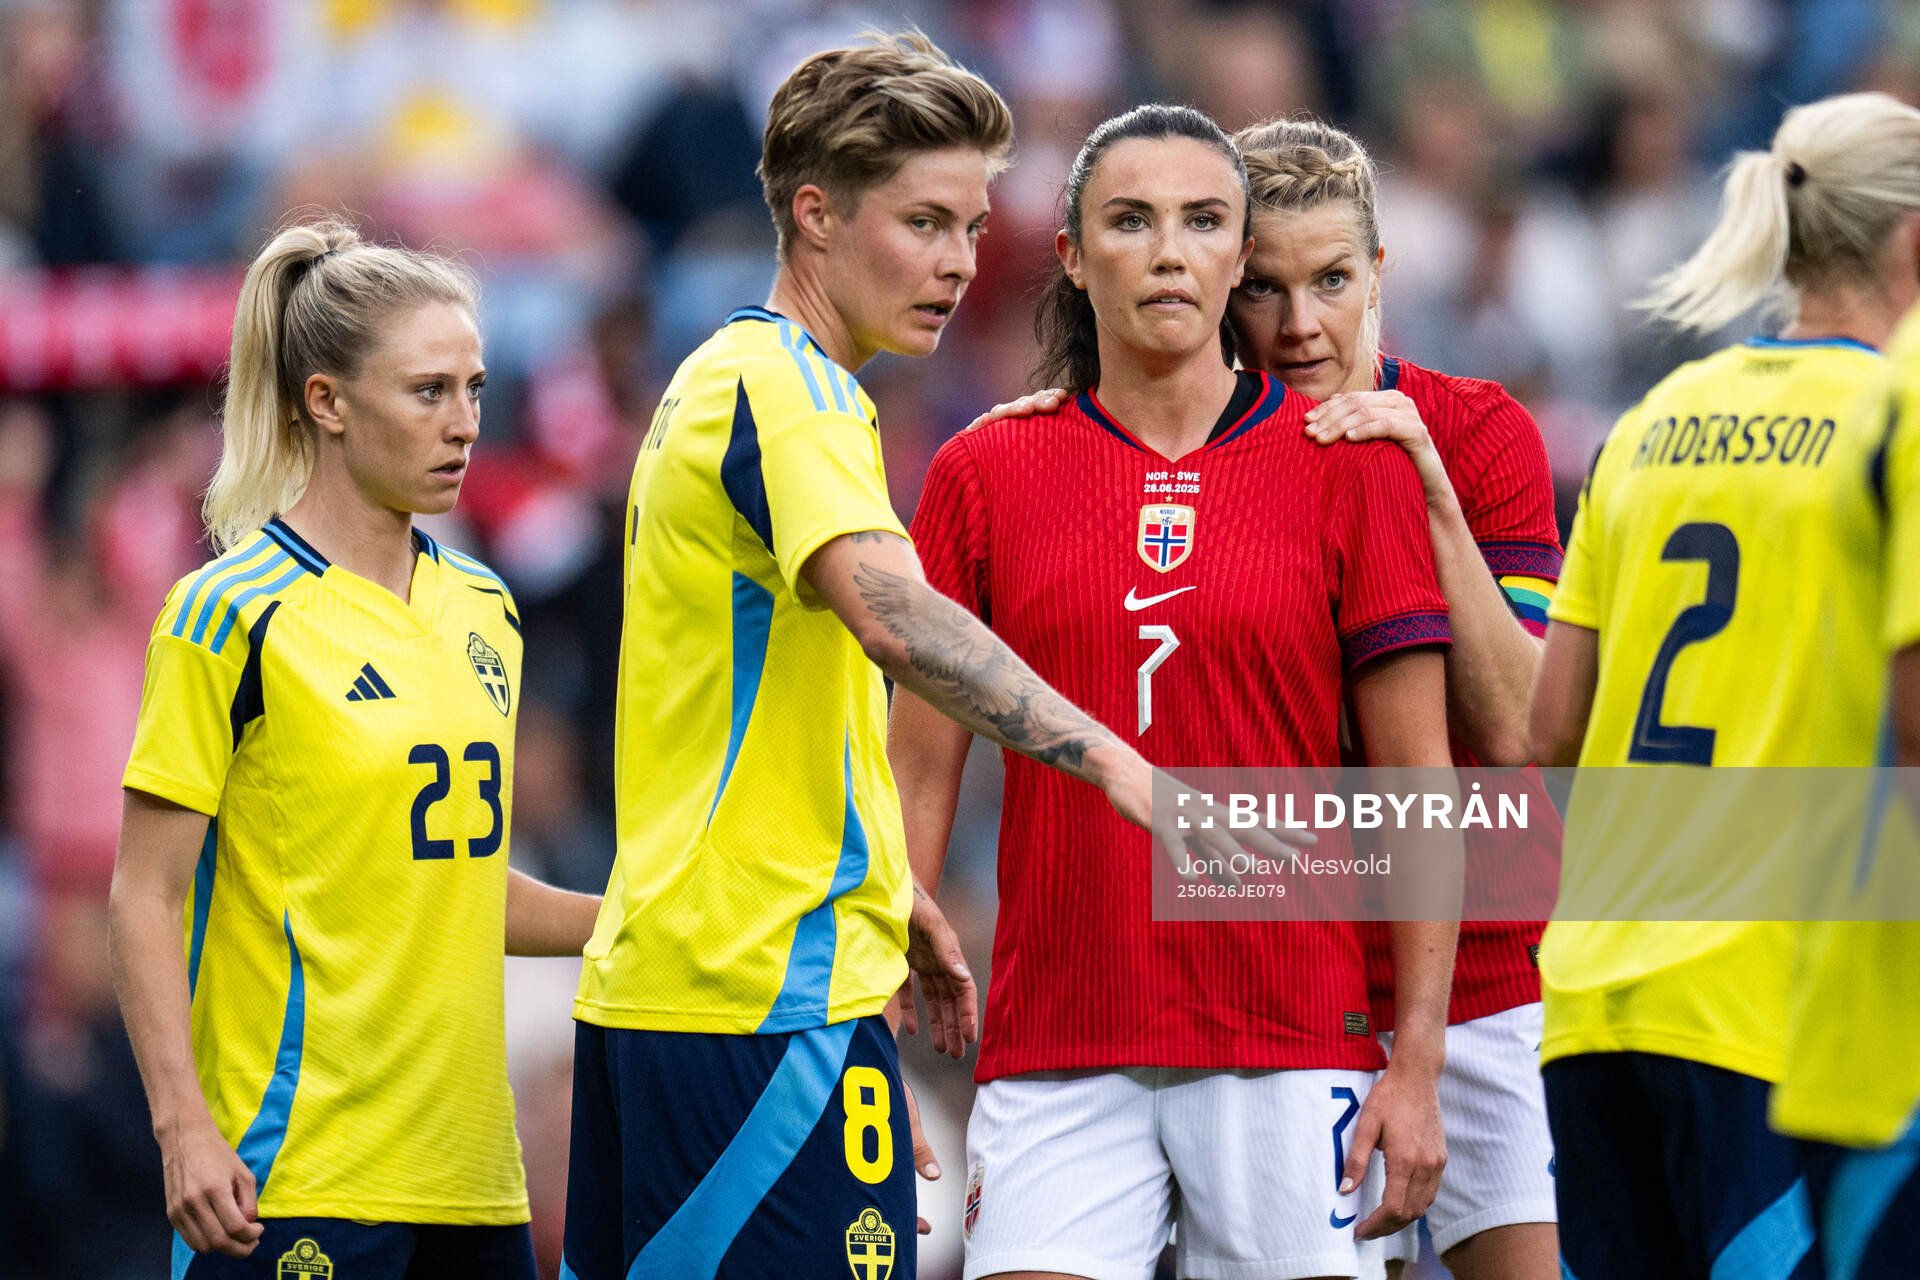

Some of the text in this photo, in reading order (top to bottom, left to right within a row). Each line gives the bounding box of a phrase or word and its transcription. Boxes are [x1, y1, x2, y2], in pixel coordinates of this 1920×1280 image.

[1144, 484, 1200, 493] 26.06.2025
[1145, 472, 1168, 481] NOR
[1176, 472, 1200, 481] SWE
[1632, 414, 1836, 471] ANDERSSON
[1137, 625, 1181, 737] 7
[1628, 522, 1740, 767] 2
[408, 742, 503, 860] 23
[843, 1066, 894, 1184] 8
[1331, 1086, 1361, 1192] 7
[287, 1263, 324, 1272] SVERIGE
